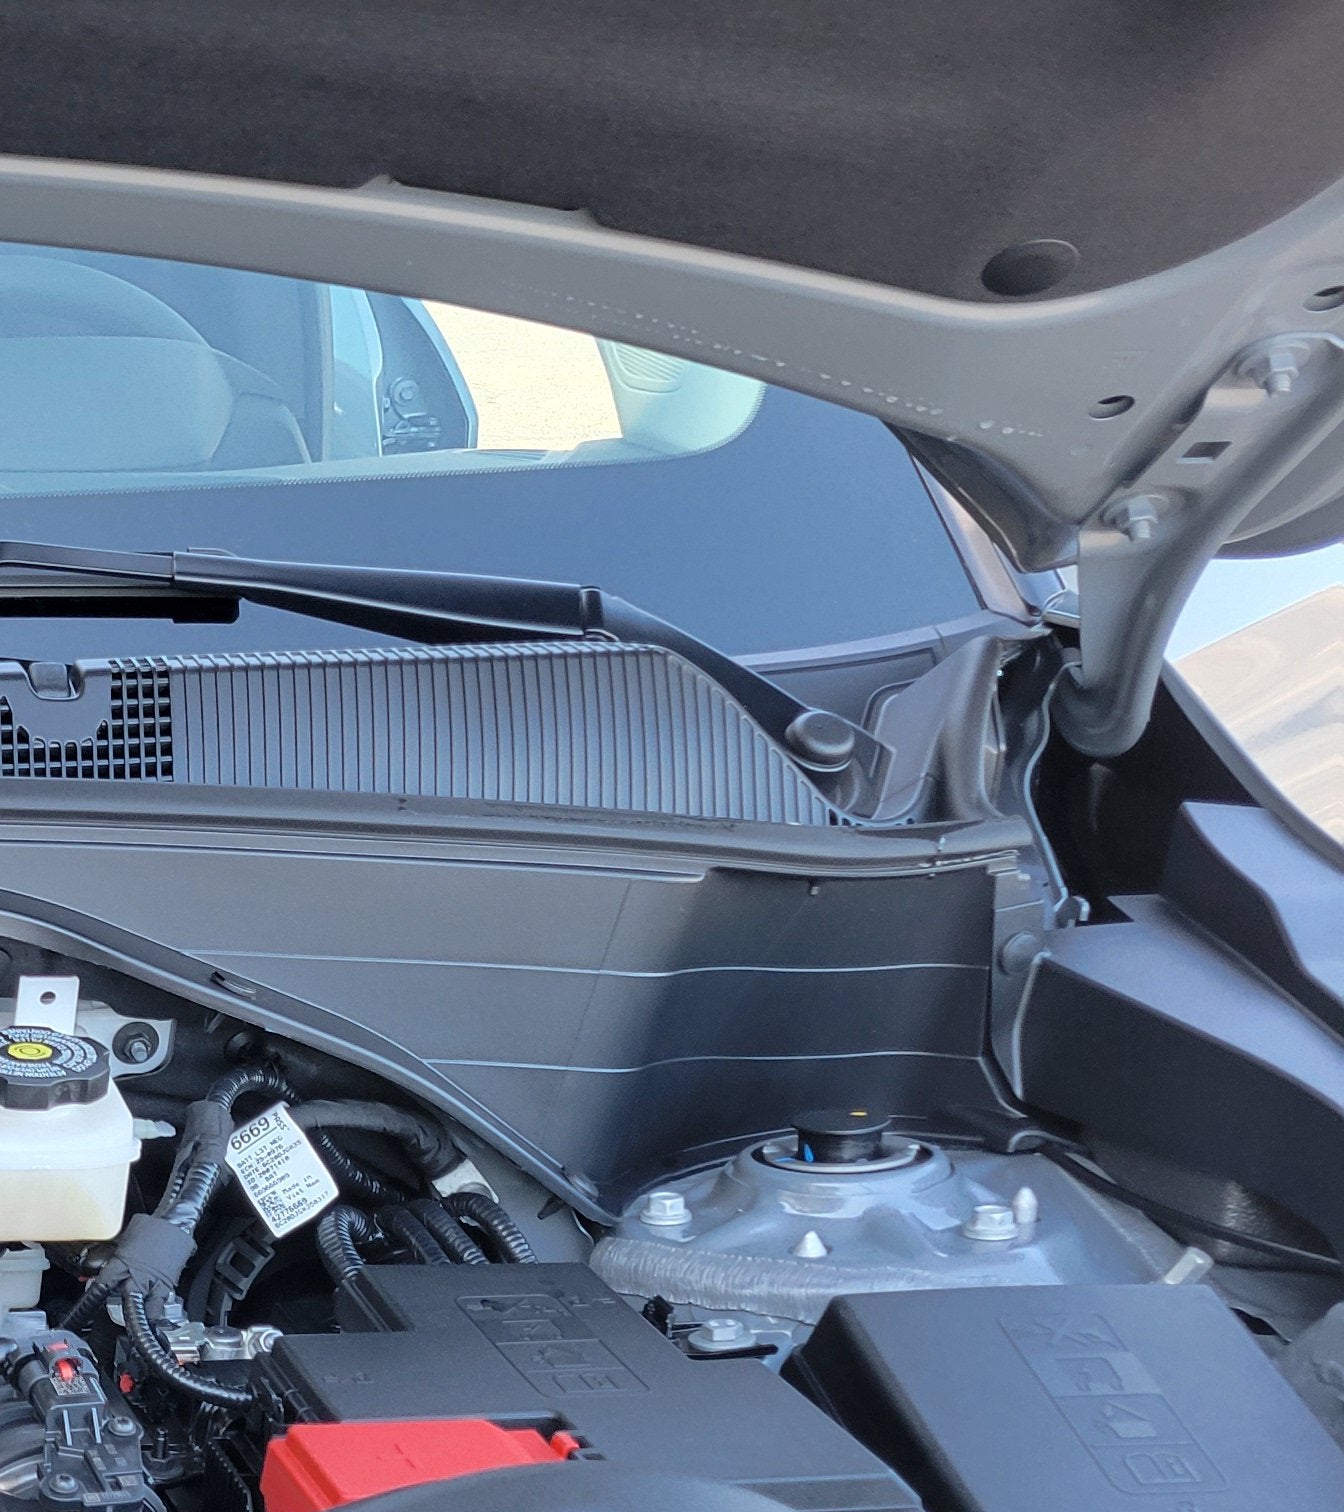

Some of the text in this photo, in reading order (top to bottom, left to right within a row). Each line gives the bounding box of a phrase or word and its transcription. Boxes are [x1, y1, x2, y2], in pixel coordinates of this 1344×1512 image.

[231, 1117, 270, 1150] 6669
[282, 1175, 312, 1195] Made in
[286, 1189, 304, 1200] Viet
